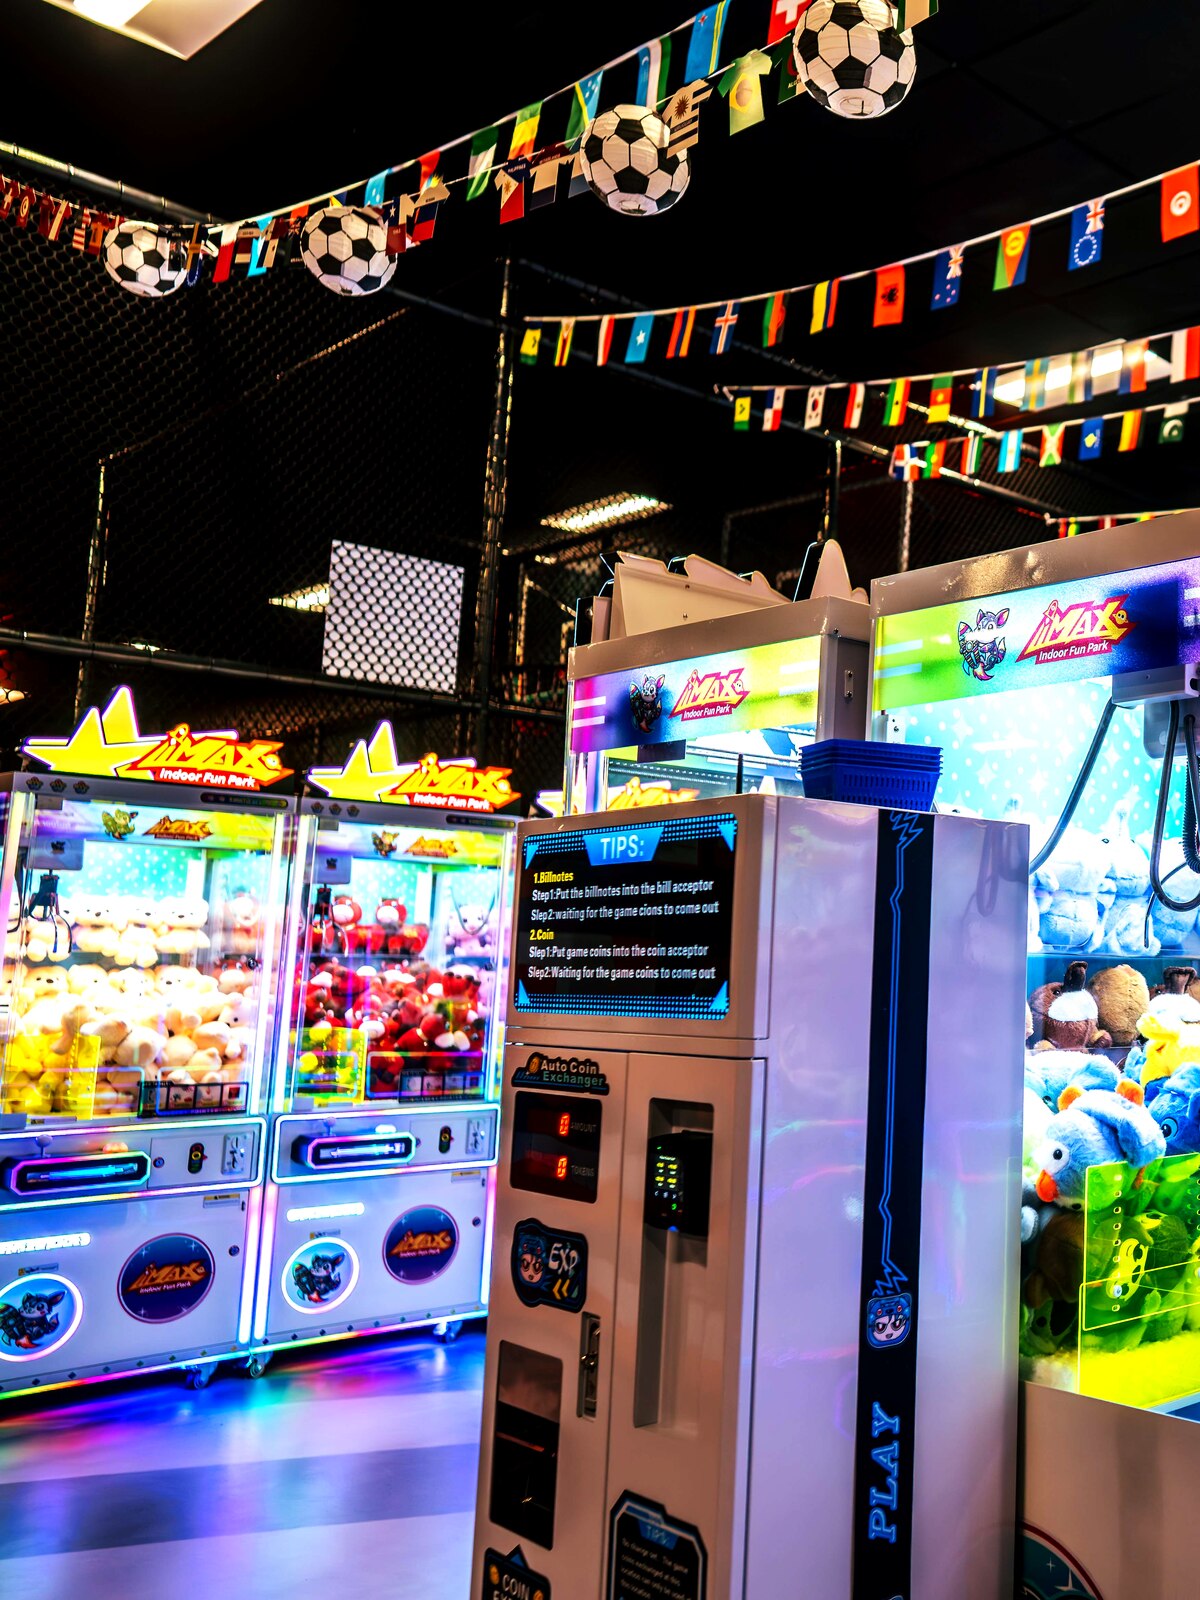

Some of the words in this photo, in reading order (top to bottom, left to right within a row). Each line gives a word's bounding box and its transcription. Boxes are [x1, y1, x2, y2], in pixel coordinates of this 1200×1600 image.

[1039, 647, 1069, 660] Indoor
[1069, 645, 1086, 656] Fun
[1088, 640, 1108, 654] Park
[683, 709, 704, 719] Indoor
[703, 706, 715, 716] Fun
[715, 703, 730, 713] Park
[160, 767, 201, 781] Indoor
[203, 773, 226, 784] Fun
[227, 775, 256, 788] Park
[413, 793, 447, 806] Indoor
[447, 796, 467, 808] Fun
[467, 798, 490, 810] Park
[601, 834, 645, 860] TIPS:
[570, 887, 584, 899] the
[584, 885, 621, 898] billnotes
[621, 884, 640, 896] into
[640, 882, 656, 895] the
[656, 880, 672, 894] bill
[672, 879, 714, 895] acceptor
[586, 906, 598, 919] for
[599, 906, 613, 918] the
[614, 907, 638, 920] game
[664, 904, 674, 915] to
[675, 904, 701, 915] come
[702, 901, 720, 914] out
[529, 928, 554, 941] 2.Coin
[566, 948, 588, 960] game
[589, 945, 612, 957] coins
[612, 944, 630, 957] into
[631, 944, 646, 957] the
[647, 943, 667, 957] coin
[667, 944, 709, 959] acceptor
[582, 966, 595, 978] for
[596, 966, 610, 978] the
[610, 968, 635, 981] game
[635, 965, 659, 979] coins
[660, 966, 671, 979] to
[671, 968, 698, 979] come
[698, 966, 716, 979] out
[541, 1060, 568, 1072] Auto
[569, 1061, 598, 1074] Coin
[542, 1071, 604, 1088] Exchanger
[548, 1243, 578, 1275] EXP
[868, 1400, 901, 1544] PLAY
[502, 1574, 530, 1600] COIN
